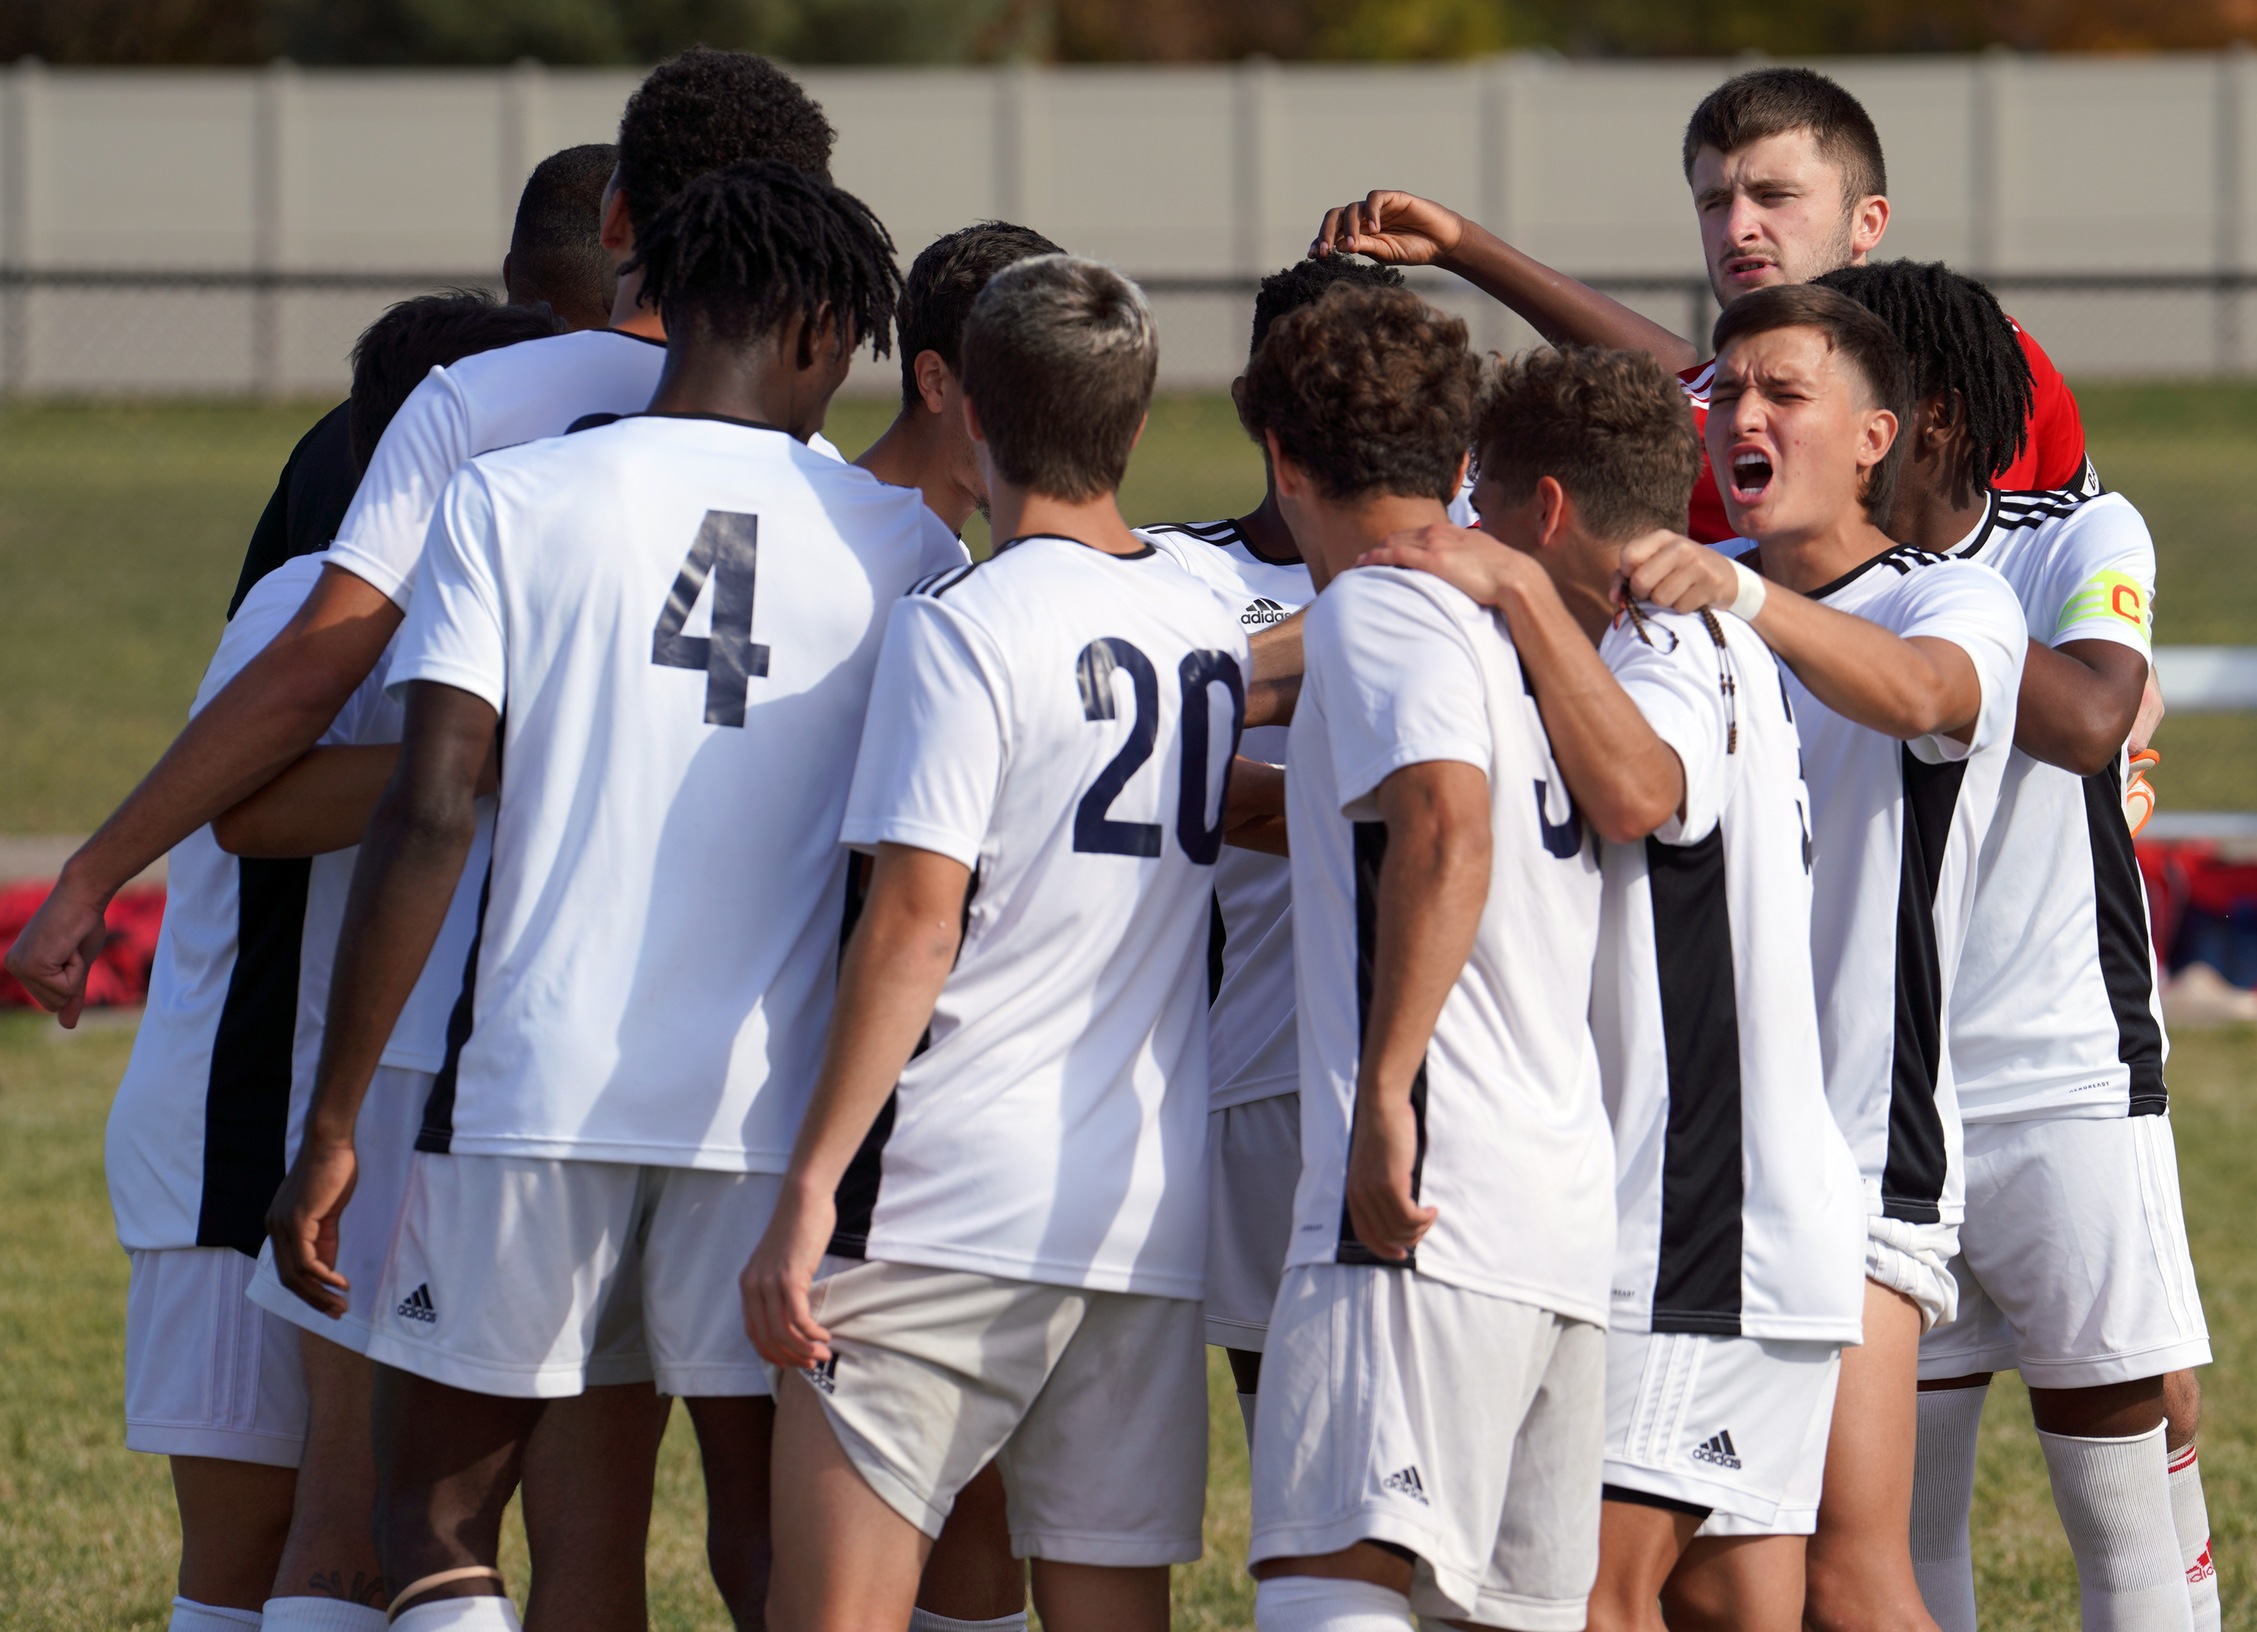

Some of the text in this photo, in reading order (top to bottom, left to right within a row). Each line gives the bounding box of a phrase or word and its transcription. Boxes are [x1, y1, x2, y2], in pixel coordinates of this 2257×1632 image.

[652, 509, 770, 728] 4
[2112, 584, 2141, 625] C
[1073, 637, 1245, 865] 20
[397, 1304, 437, 1324] adidas
[1693, 1449, 1741, 1470] adidas
